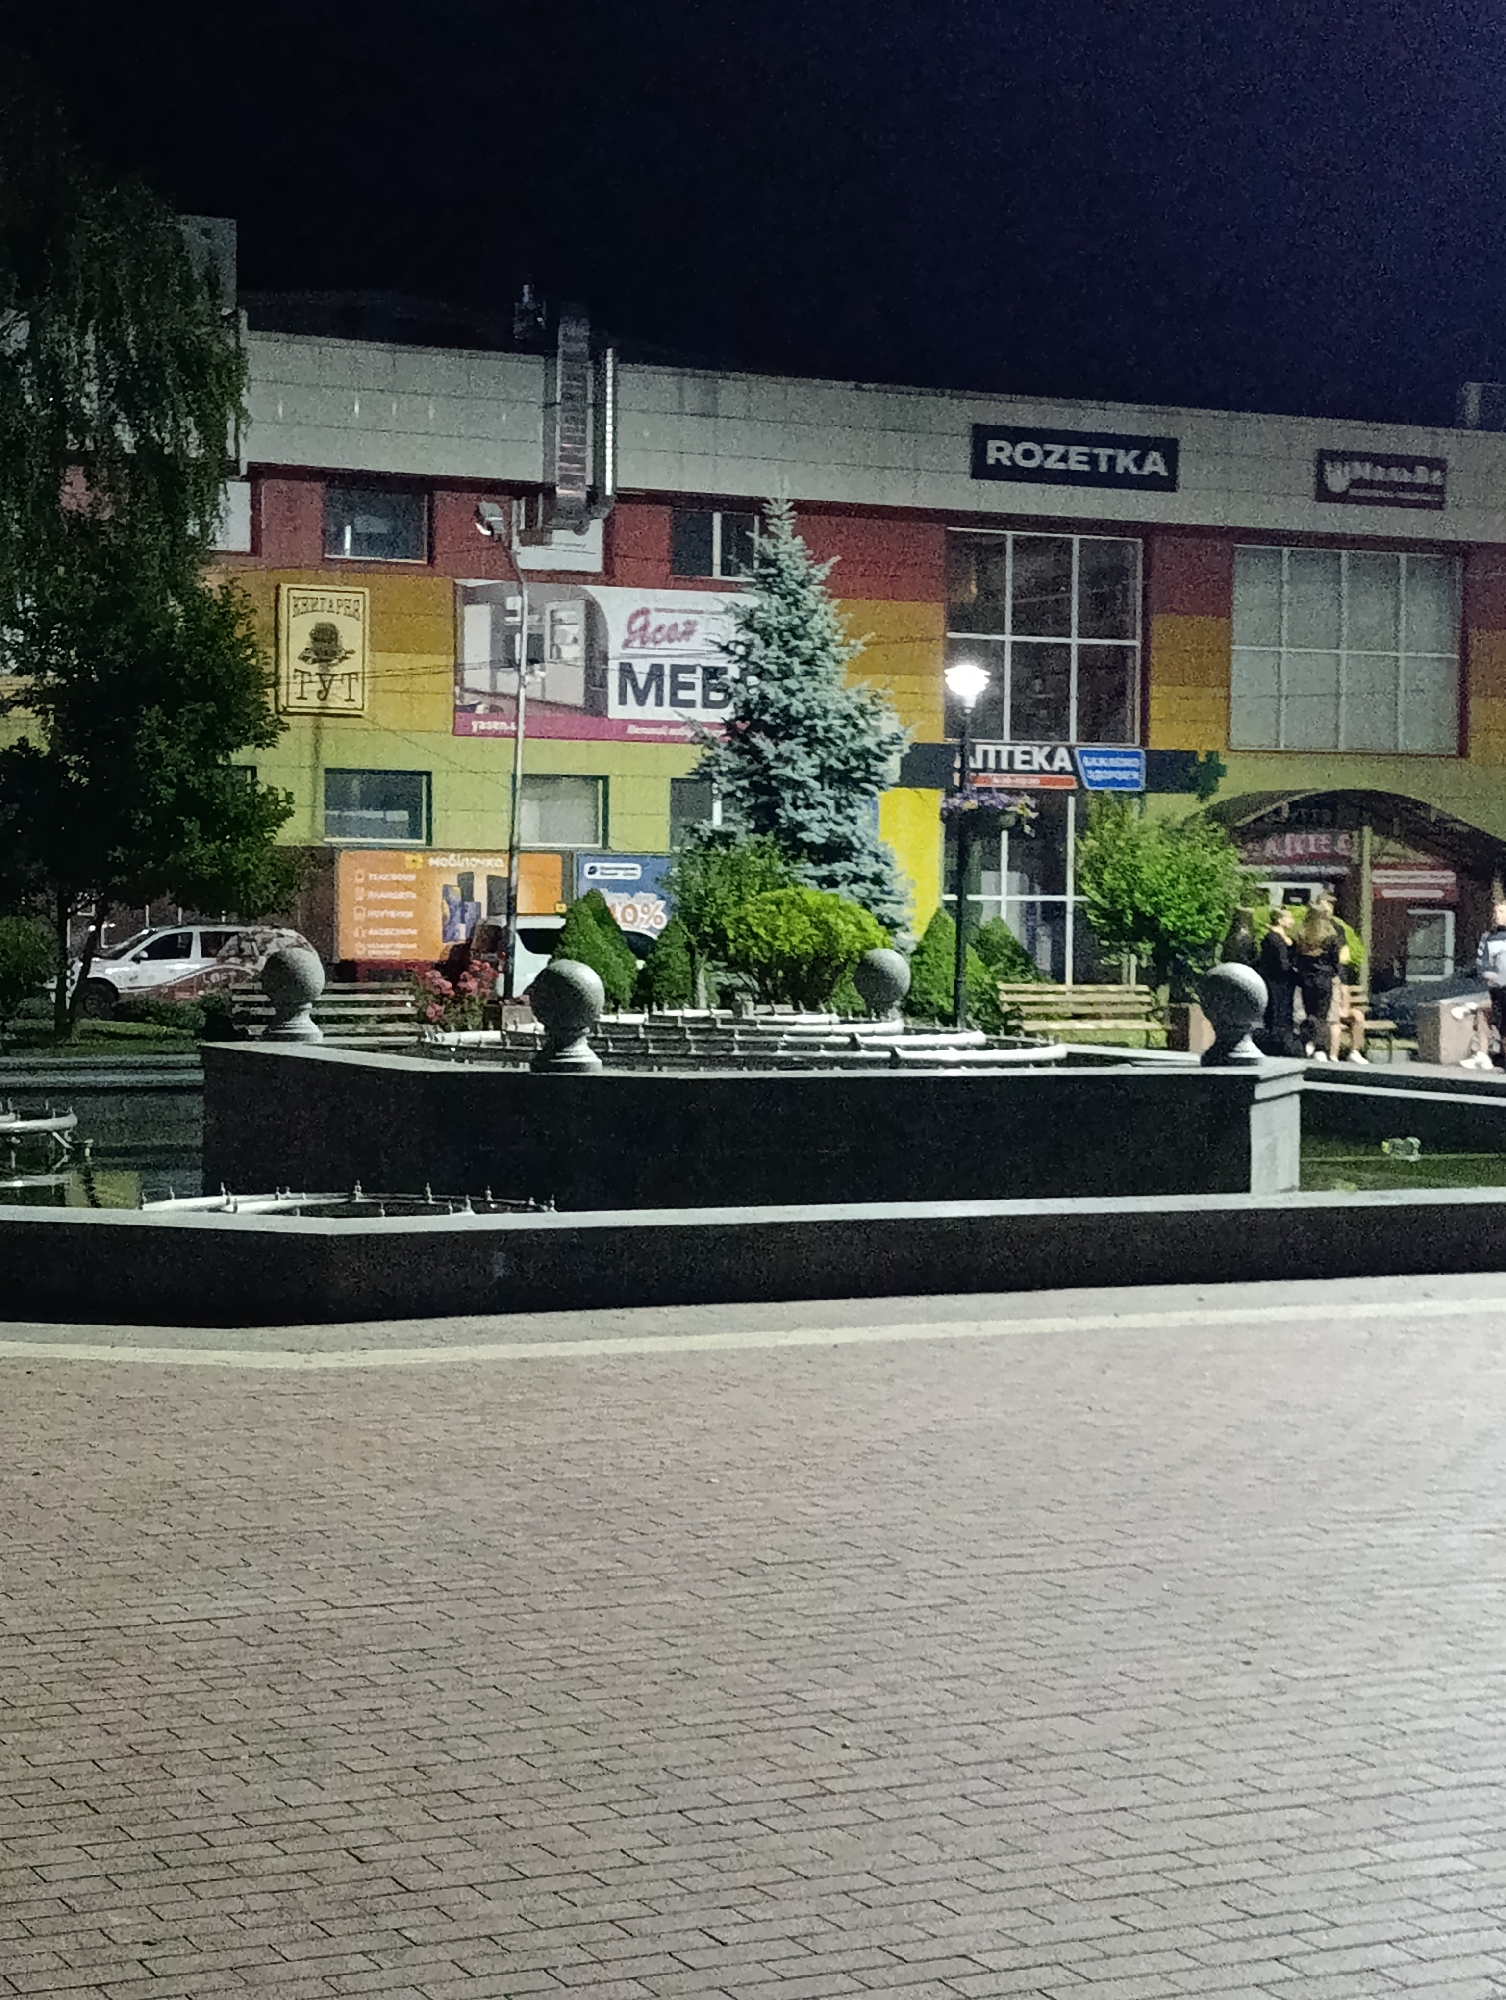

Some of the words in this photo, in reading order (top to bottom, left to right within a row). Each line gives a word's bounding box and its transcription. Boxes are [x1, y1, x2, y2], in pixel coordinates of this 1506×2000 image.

[986, 439, 1169, 476] ROZETKA
[293, 668, 360, 702] ТУТ
[618, 661, 731, 710] МЕБ
[428, 853, 505, 869] мобілочка
